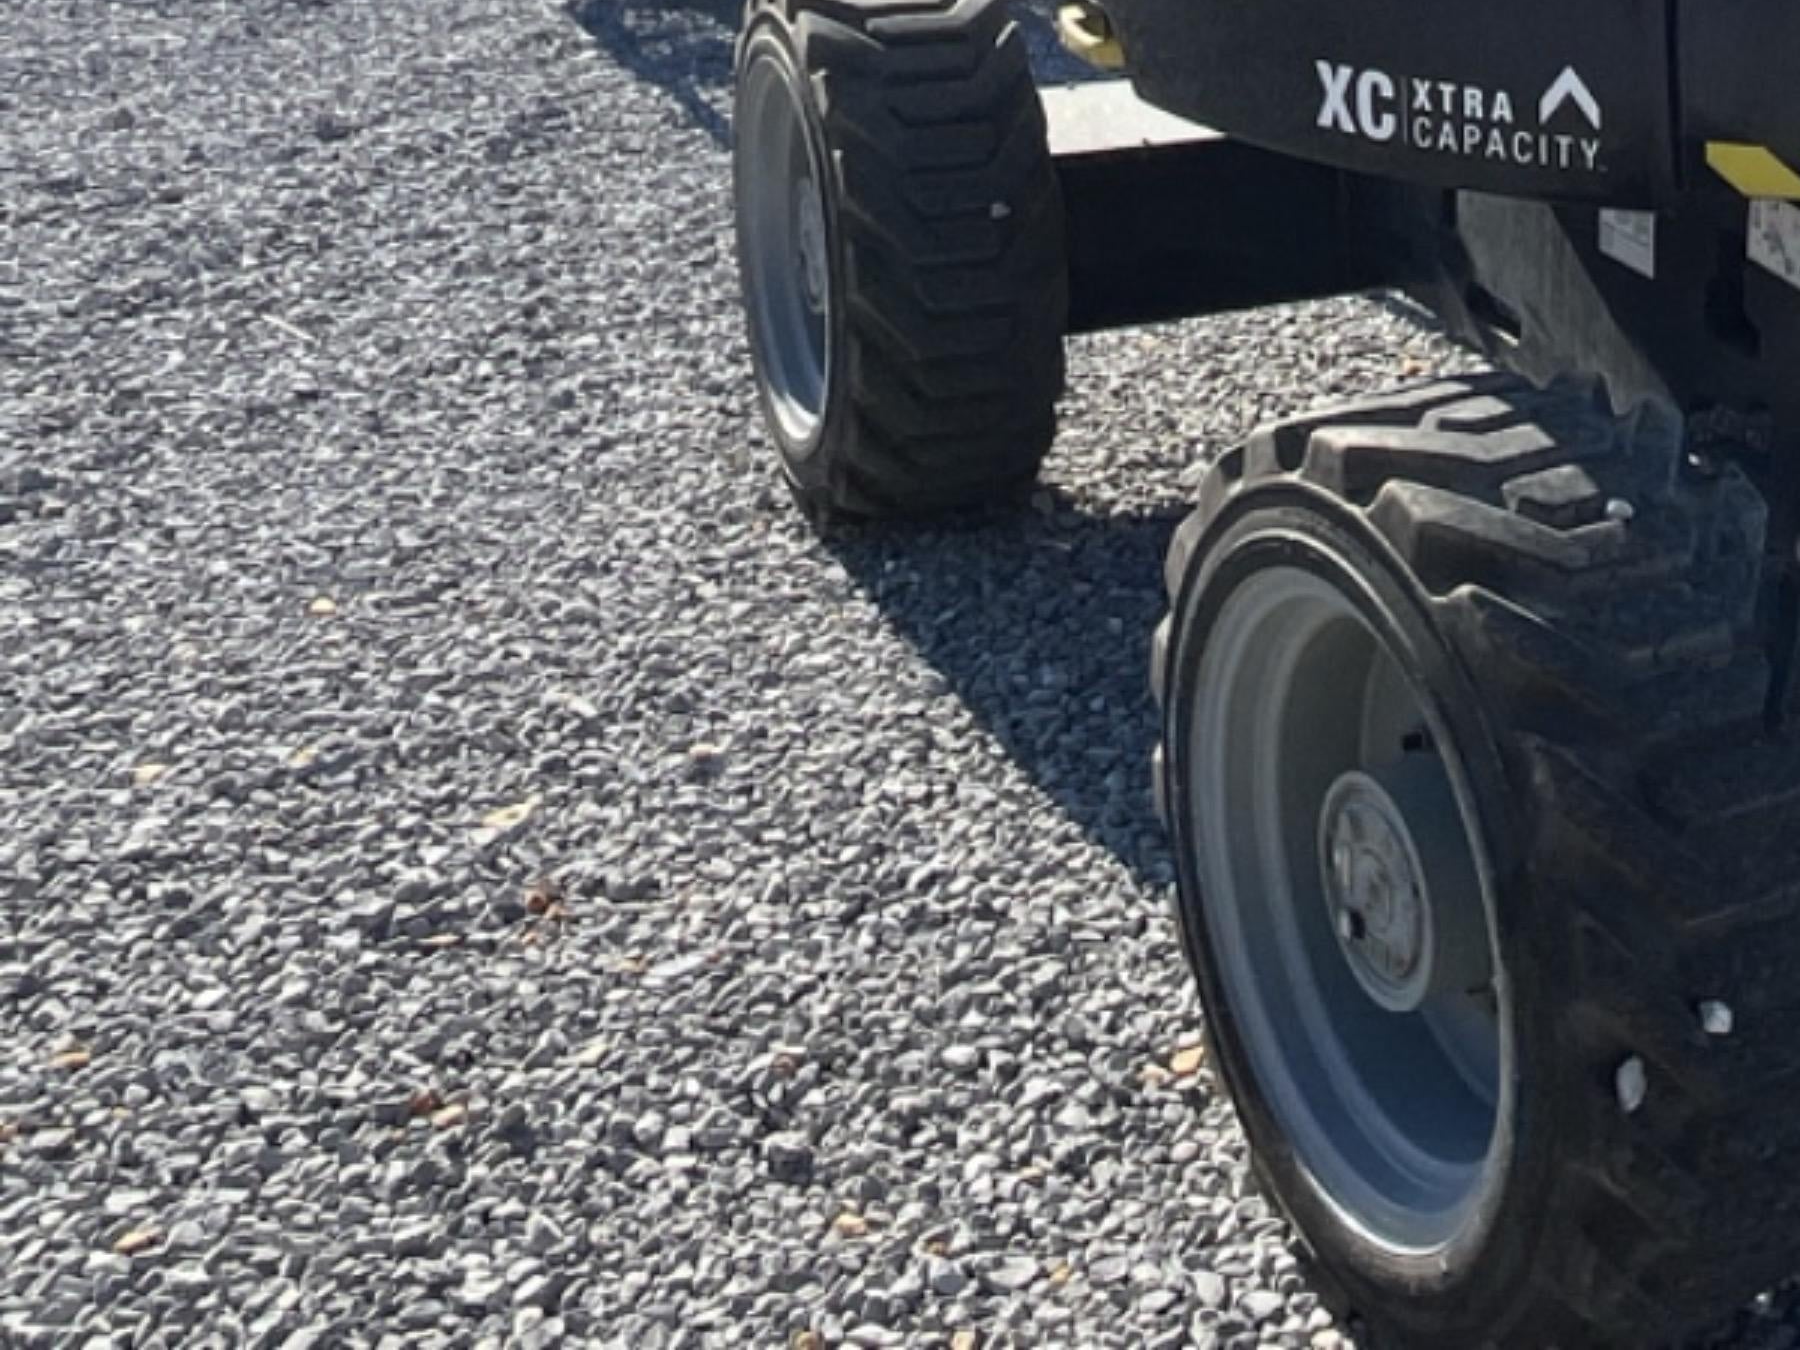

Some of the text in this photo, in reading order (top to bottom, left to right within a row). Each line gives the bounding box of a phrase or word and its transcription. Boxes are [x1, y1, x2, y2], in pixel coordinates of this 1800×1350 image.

[1315, 58, 1514, 142] XC XTRA
[1411, 115, 1601, 172] CAPACITY
